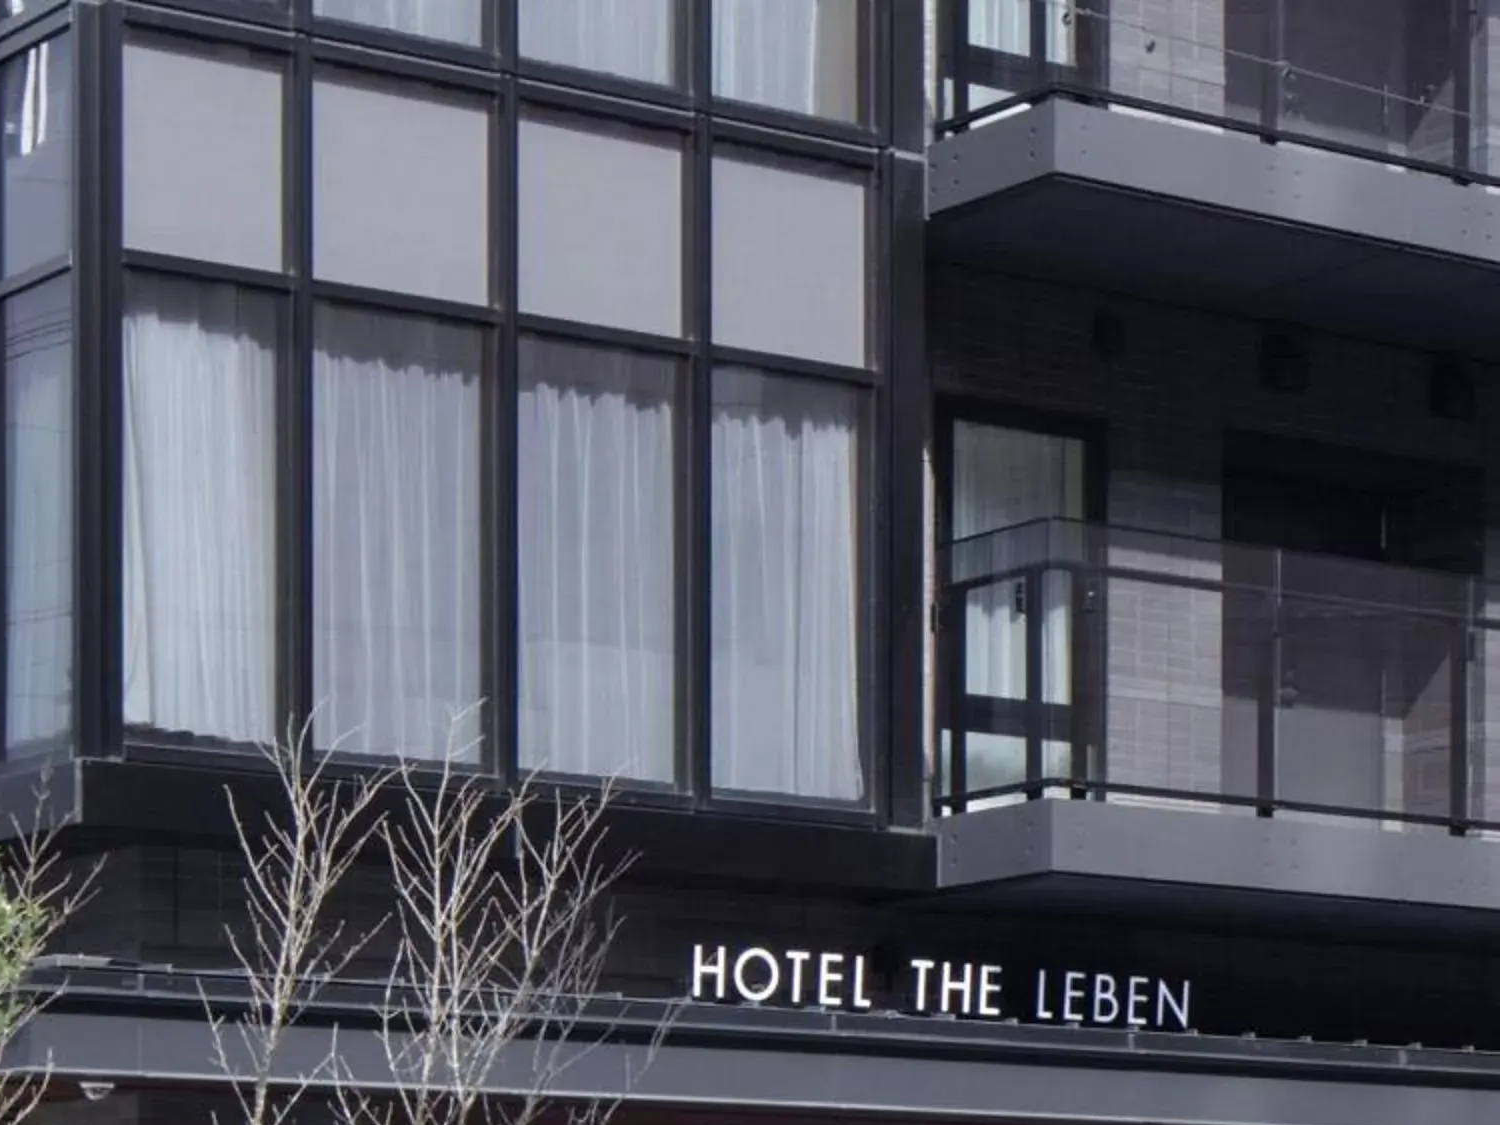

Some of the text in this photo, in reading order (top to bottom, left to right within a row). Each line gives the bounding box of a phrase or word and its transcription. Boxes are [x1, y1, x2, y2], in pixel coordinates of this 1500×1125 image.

[692, 944, 1190, 1028] HOTEL THE LEBEN
